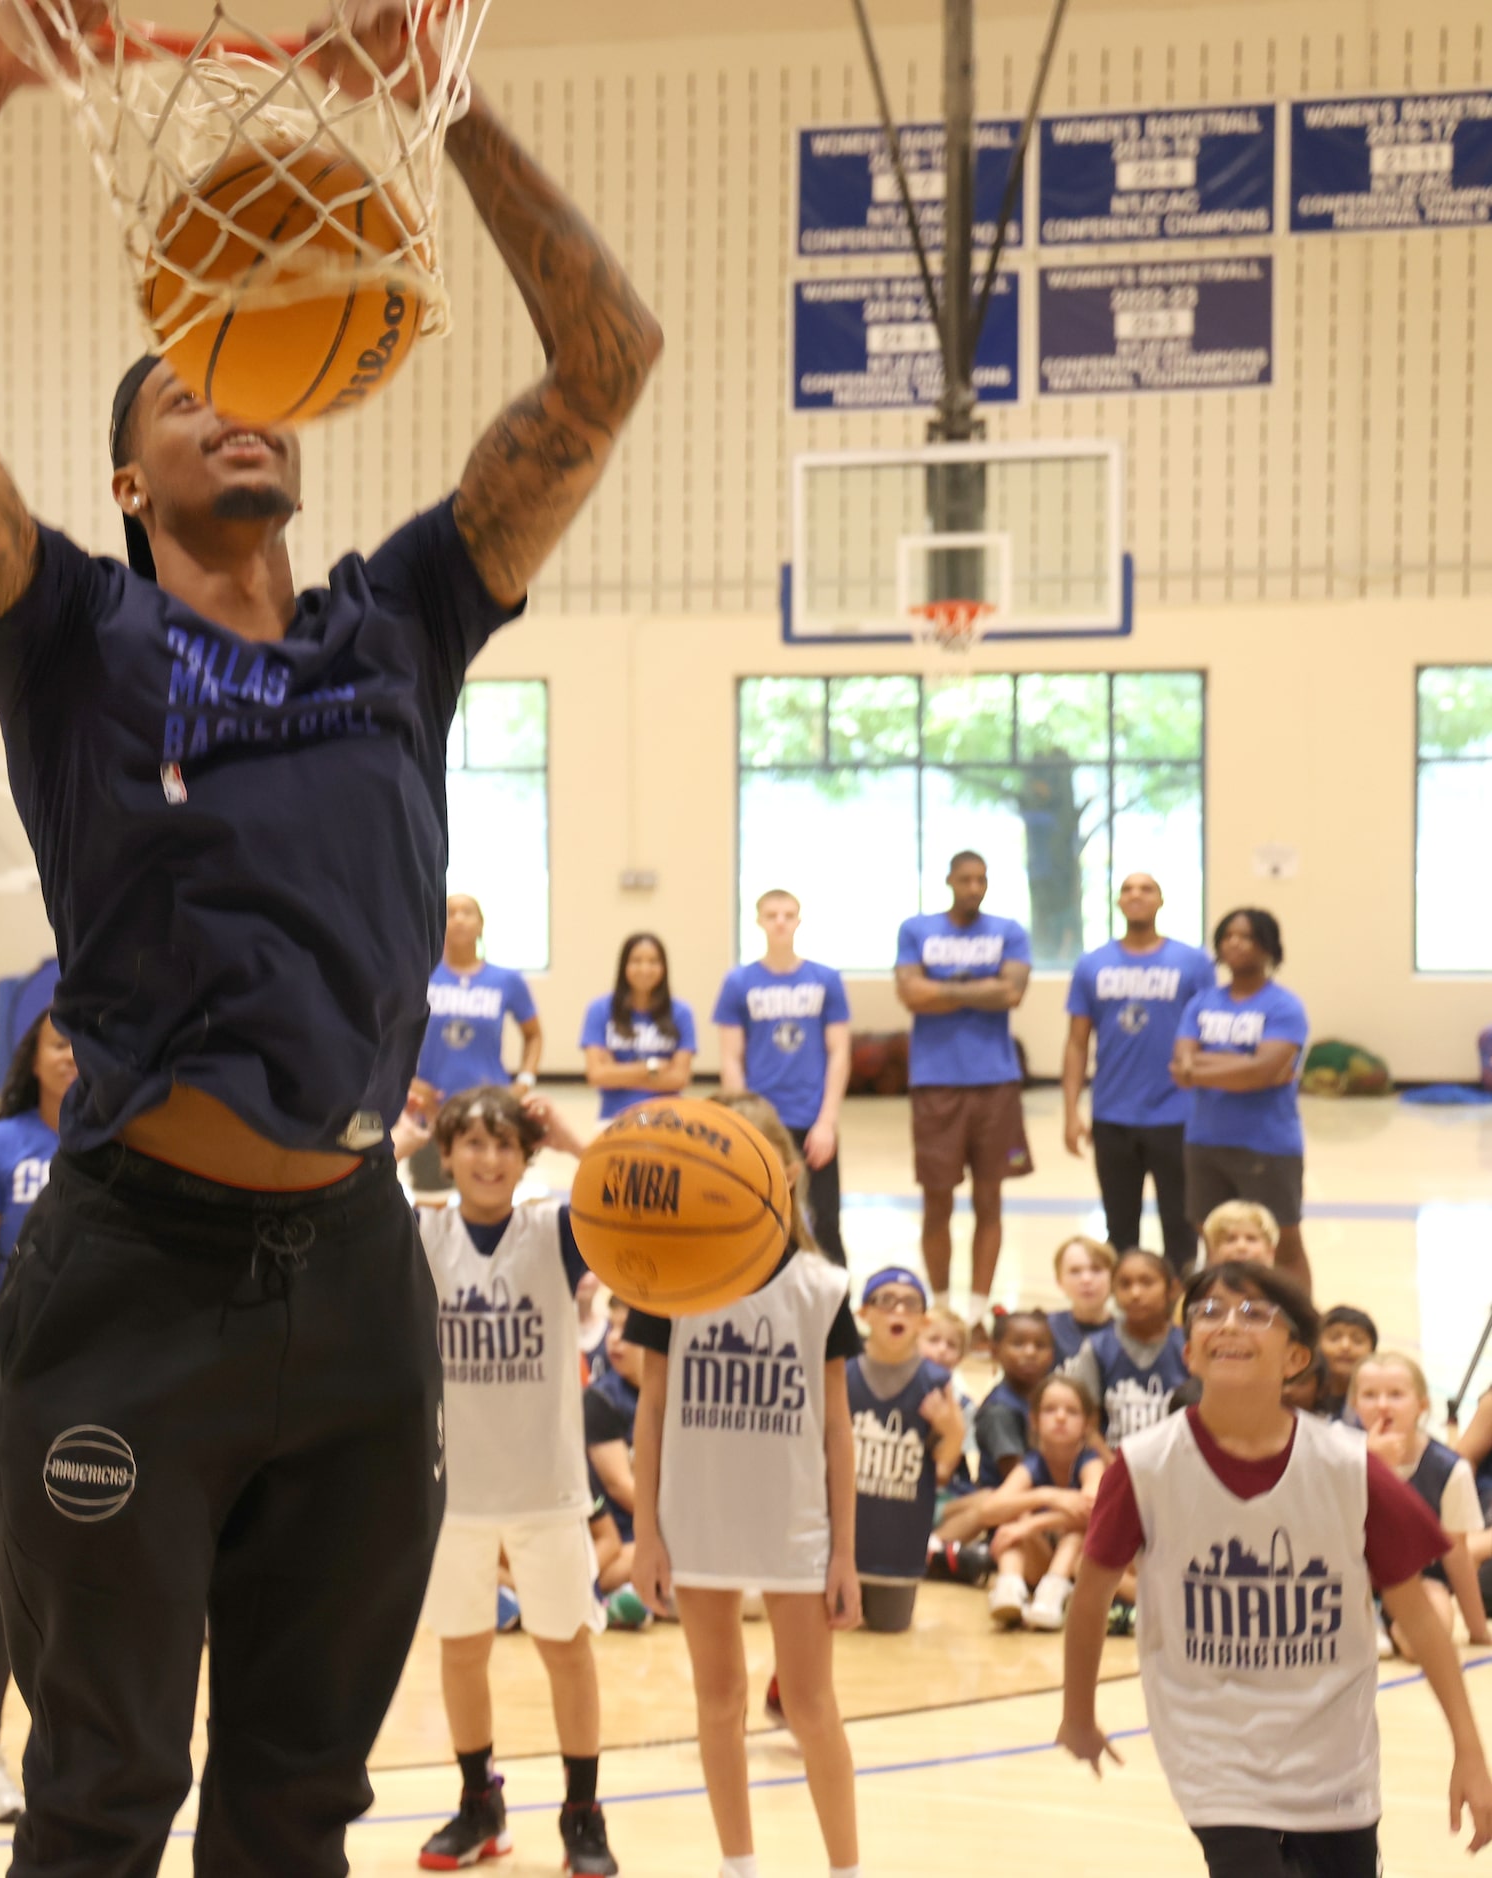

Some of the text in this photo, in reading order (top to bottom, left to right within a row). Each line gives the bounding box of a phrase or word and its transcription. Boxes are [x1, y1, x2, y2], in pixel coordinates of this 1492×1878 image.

[921, 934, 1005, 968] COACH
[745, 981, 828, 1021] COACH
[1095, 965, 1181, 1001] COACH
[623, 1159, 681, 1219] NBA
[438, 1316, 545, 1361] MAVS
[682, 1355, 806, 1411] MAVS
[680, 1405, 803, 1437] BASKETBALL
[51, 1457, 129, 1487] MAVERICKS
[1184, 1577, 1343, 1638] MAVS
[1185, 1637, 1340, 1669] BASKETBALL
